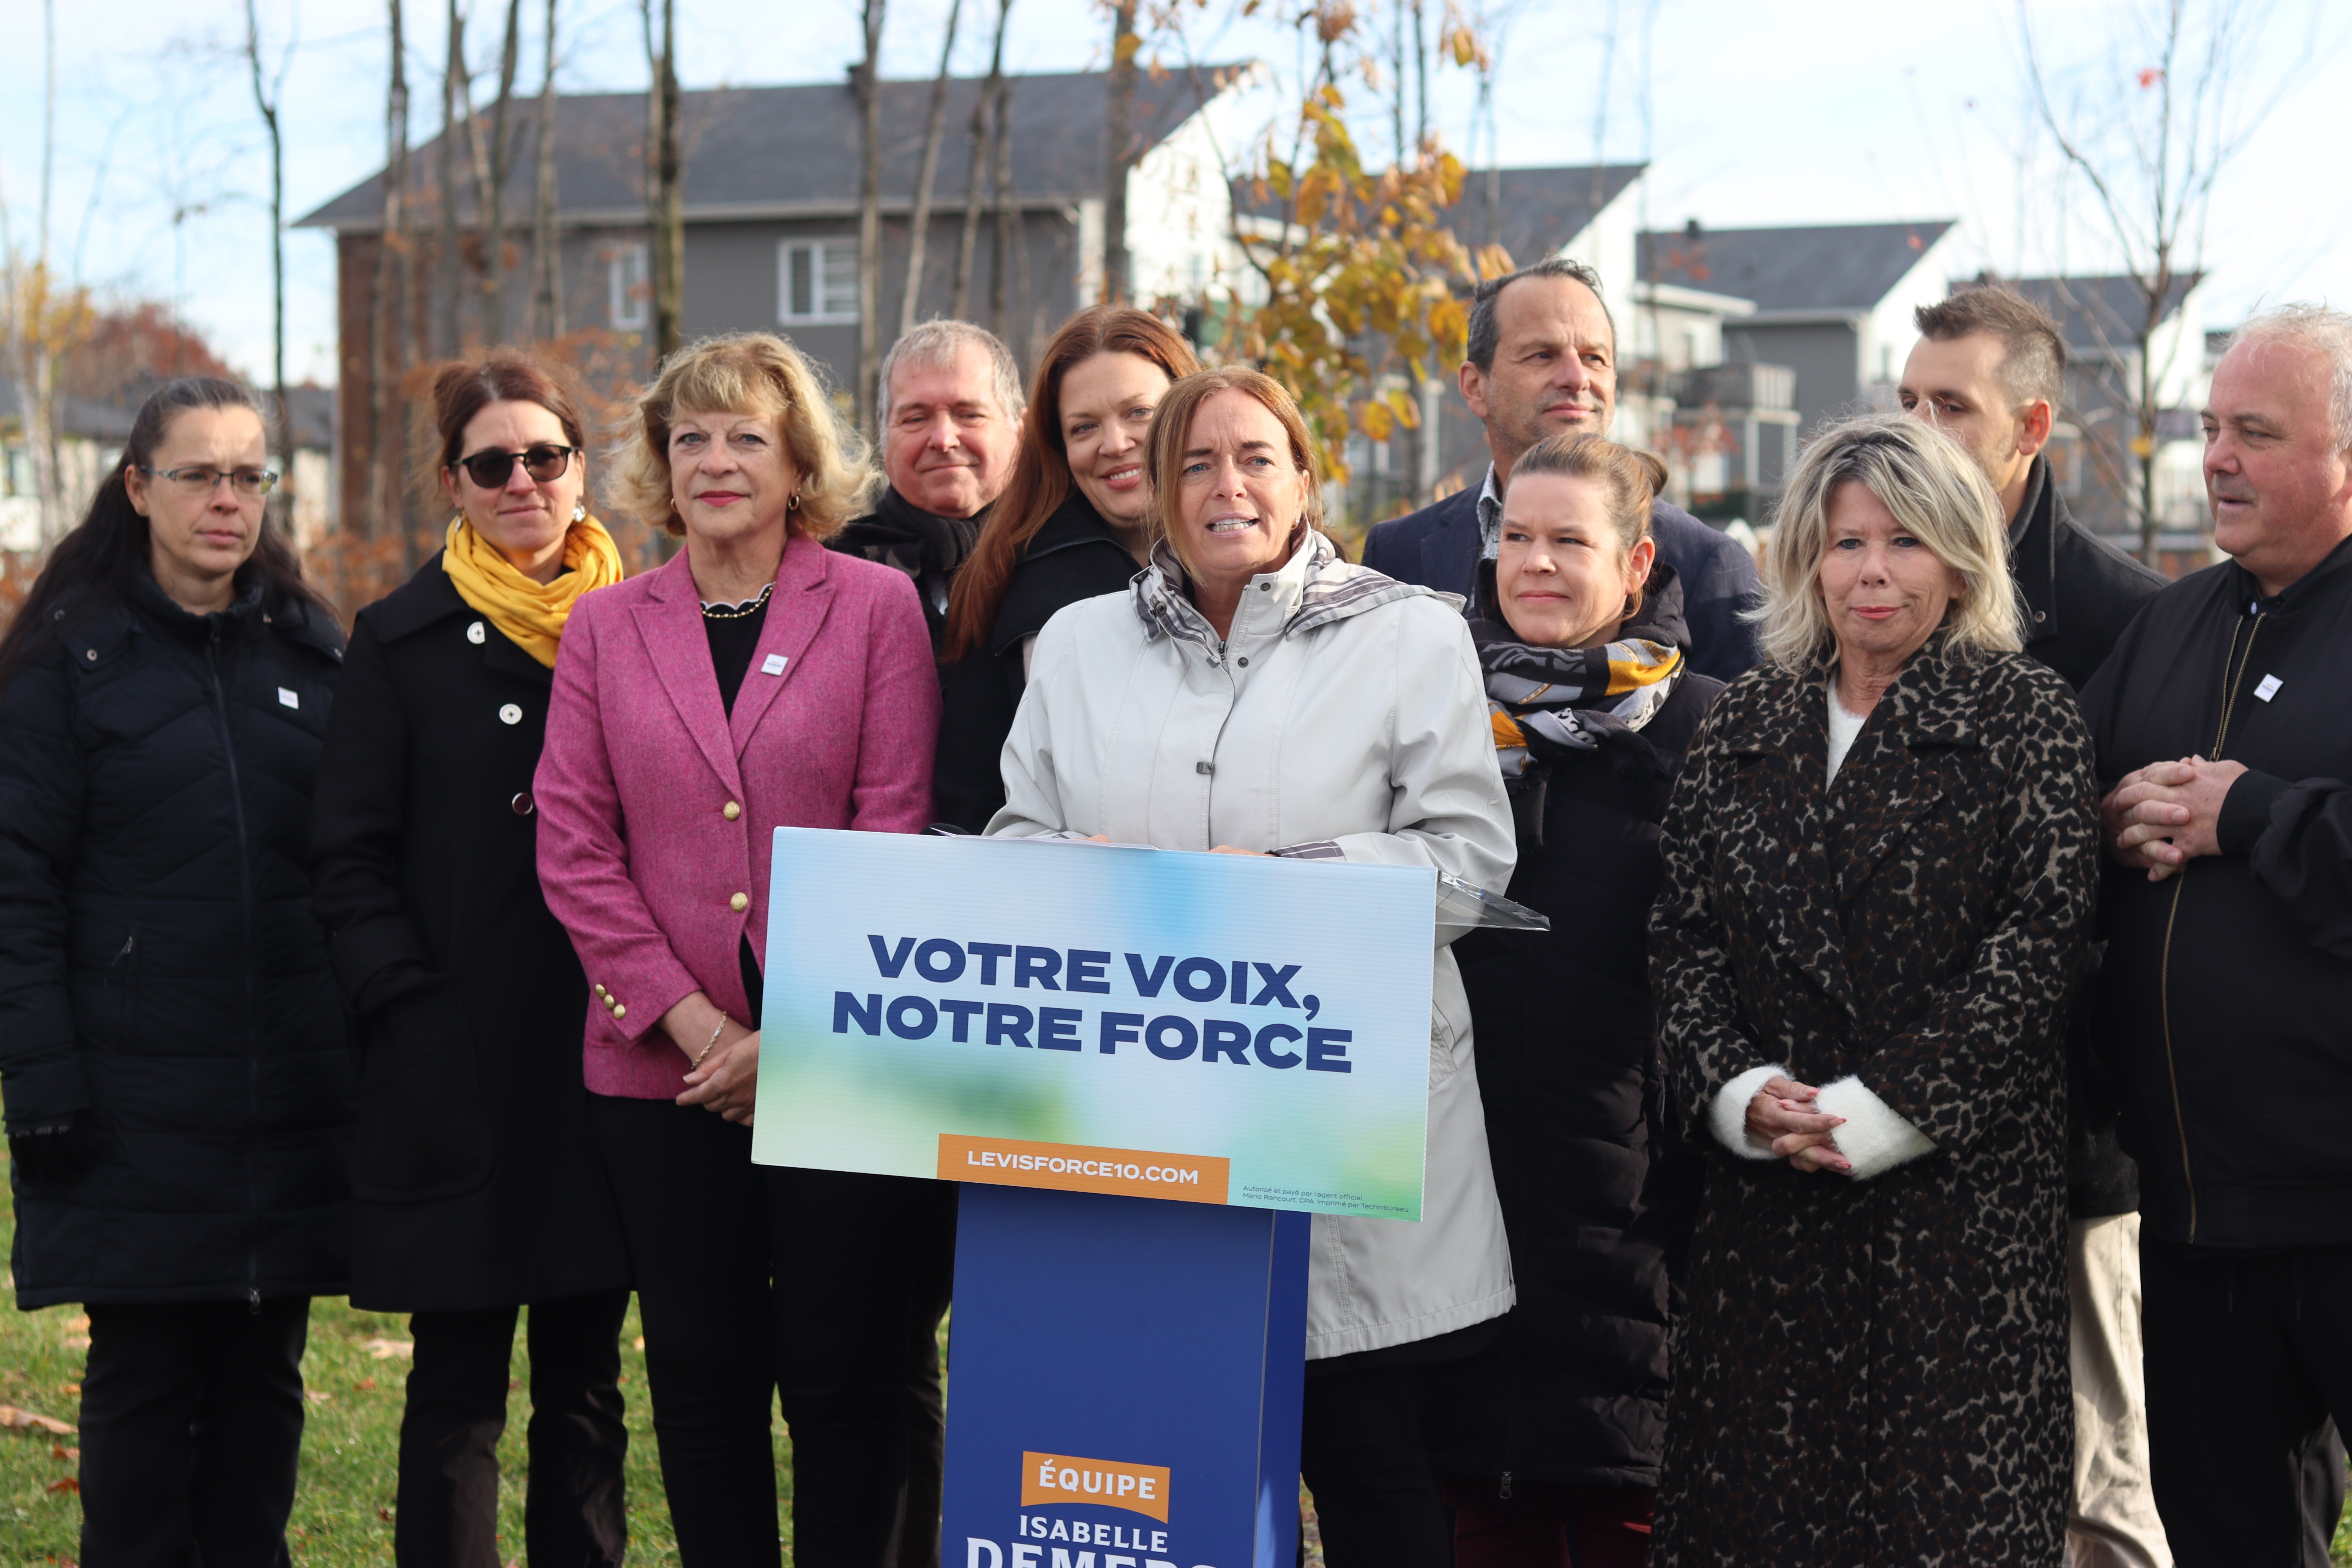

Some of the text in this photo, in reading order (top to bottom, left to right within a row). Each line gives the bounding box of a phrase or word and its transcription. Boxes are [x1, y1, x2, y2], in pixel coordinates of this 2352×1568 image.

[867, 935, 1320, 1022] VOTRE VOIX,
[833, 991, 1352, 1073] NOTRE FORCE
[967, 1150, 1198, 1185] LEVISFORCE10.COM
[1263, 1194, 1298, 1203] Rancourt,
[1361, 1203, 1410, 1212] Technibureau.
[1039, 1458, 1156, 1500] ÉQUIPE
[967, 1537, 1217, 1568] DEM
[1020, 1515, 1168, 1553] ISABELLE
